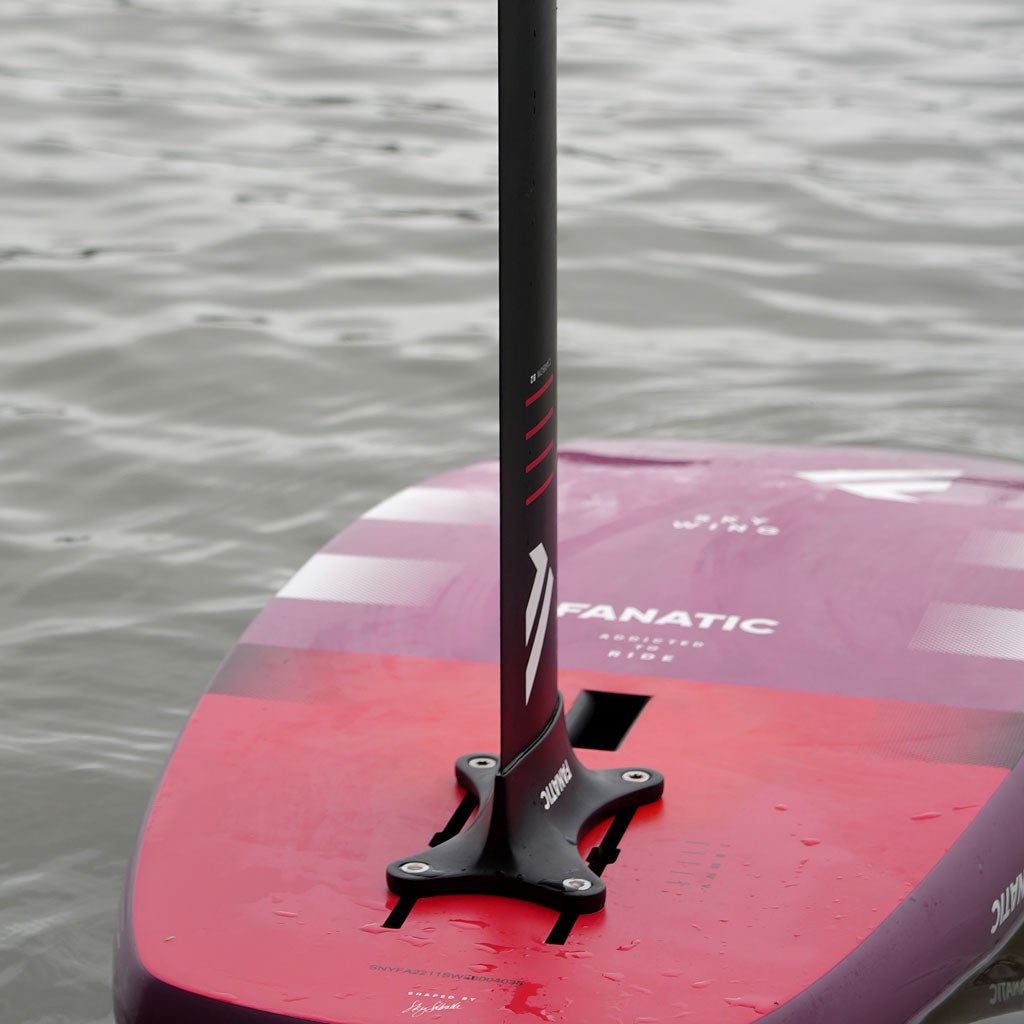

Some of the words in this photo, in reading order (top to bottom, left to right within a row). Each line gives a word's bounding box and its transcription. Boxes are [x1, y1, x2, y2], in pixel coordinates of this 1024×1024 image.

[672, 519, 780, 536] WING
[557, 601, 780, 635] FANATIC
[599, 632, 705, 648] ADDICTED
[607, 649, 675, 663] RIDE
[539, 758, 573, 810] FANATIC
[407, 991, 455, 1000] SHAPED
